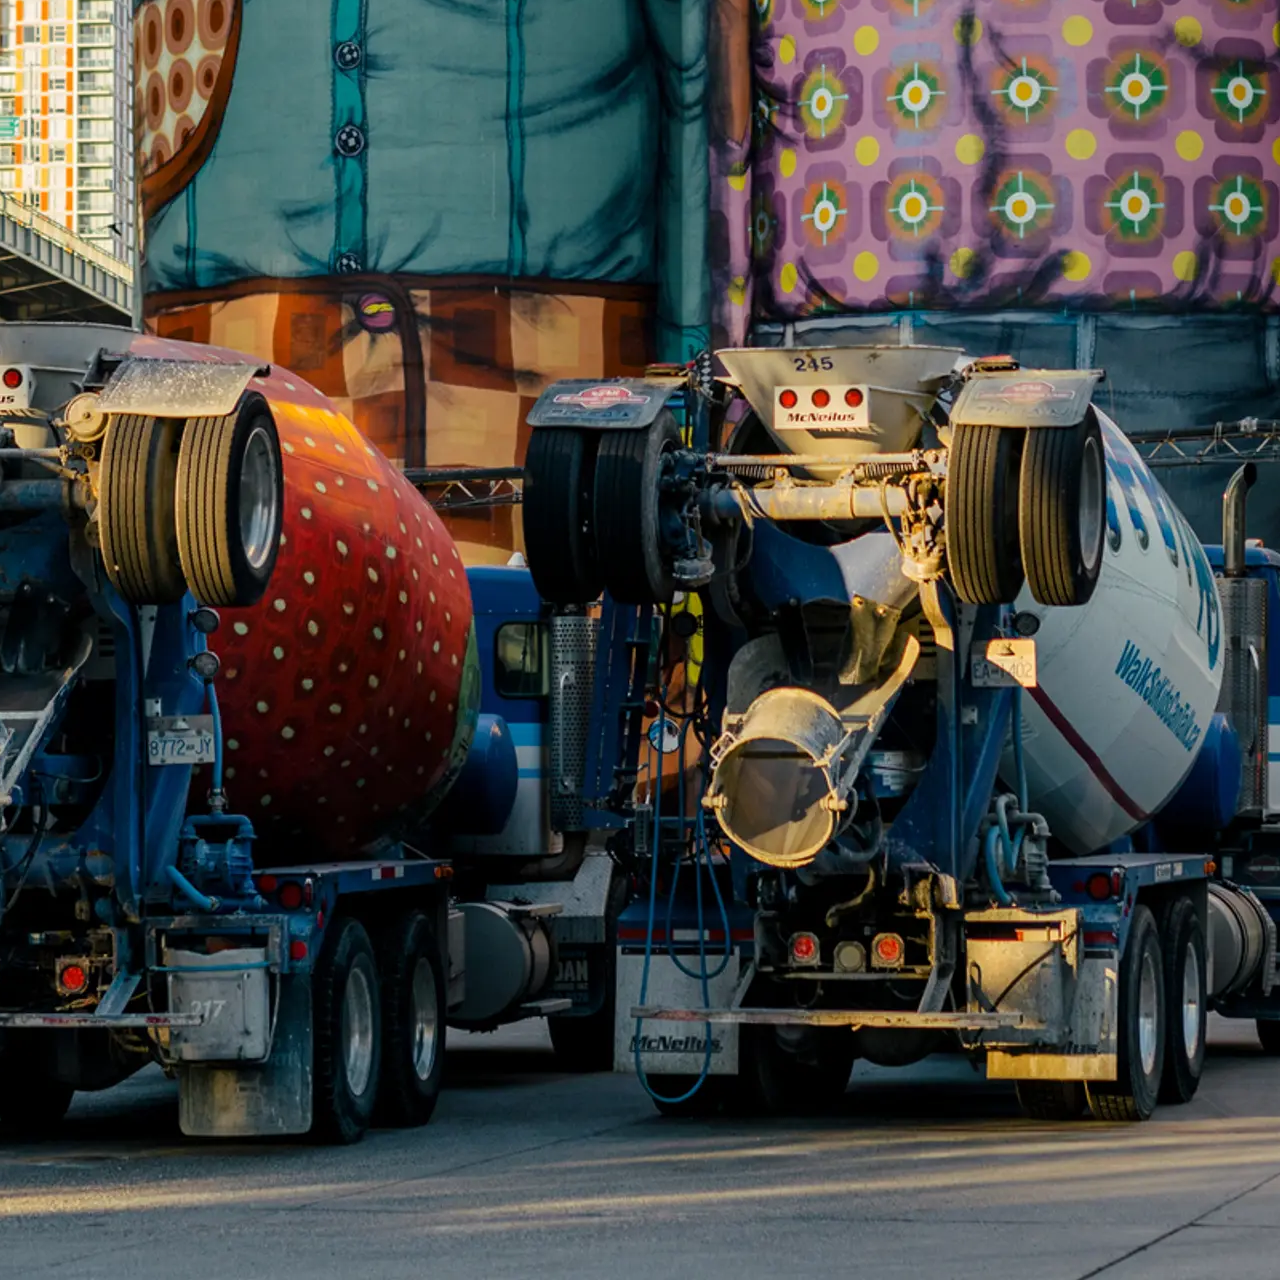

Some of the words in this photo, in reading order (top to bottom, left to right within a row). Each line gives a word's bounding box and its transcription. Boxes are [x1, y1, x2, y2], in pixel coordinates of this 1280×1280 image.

[793, 356, 834, 372] 245
[786, 412, 856, 423] McNeilus
[191, 1000, 225, 1018] 217
